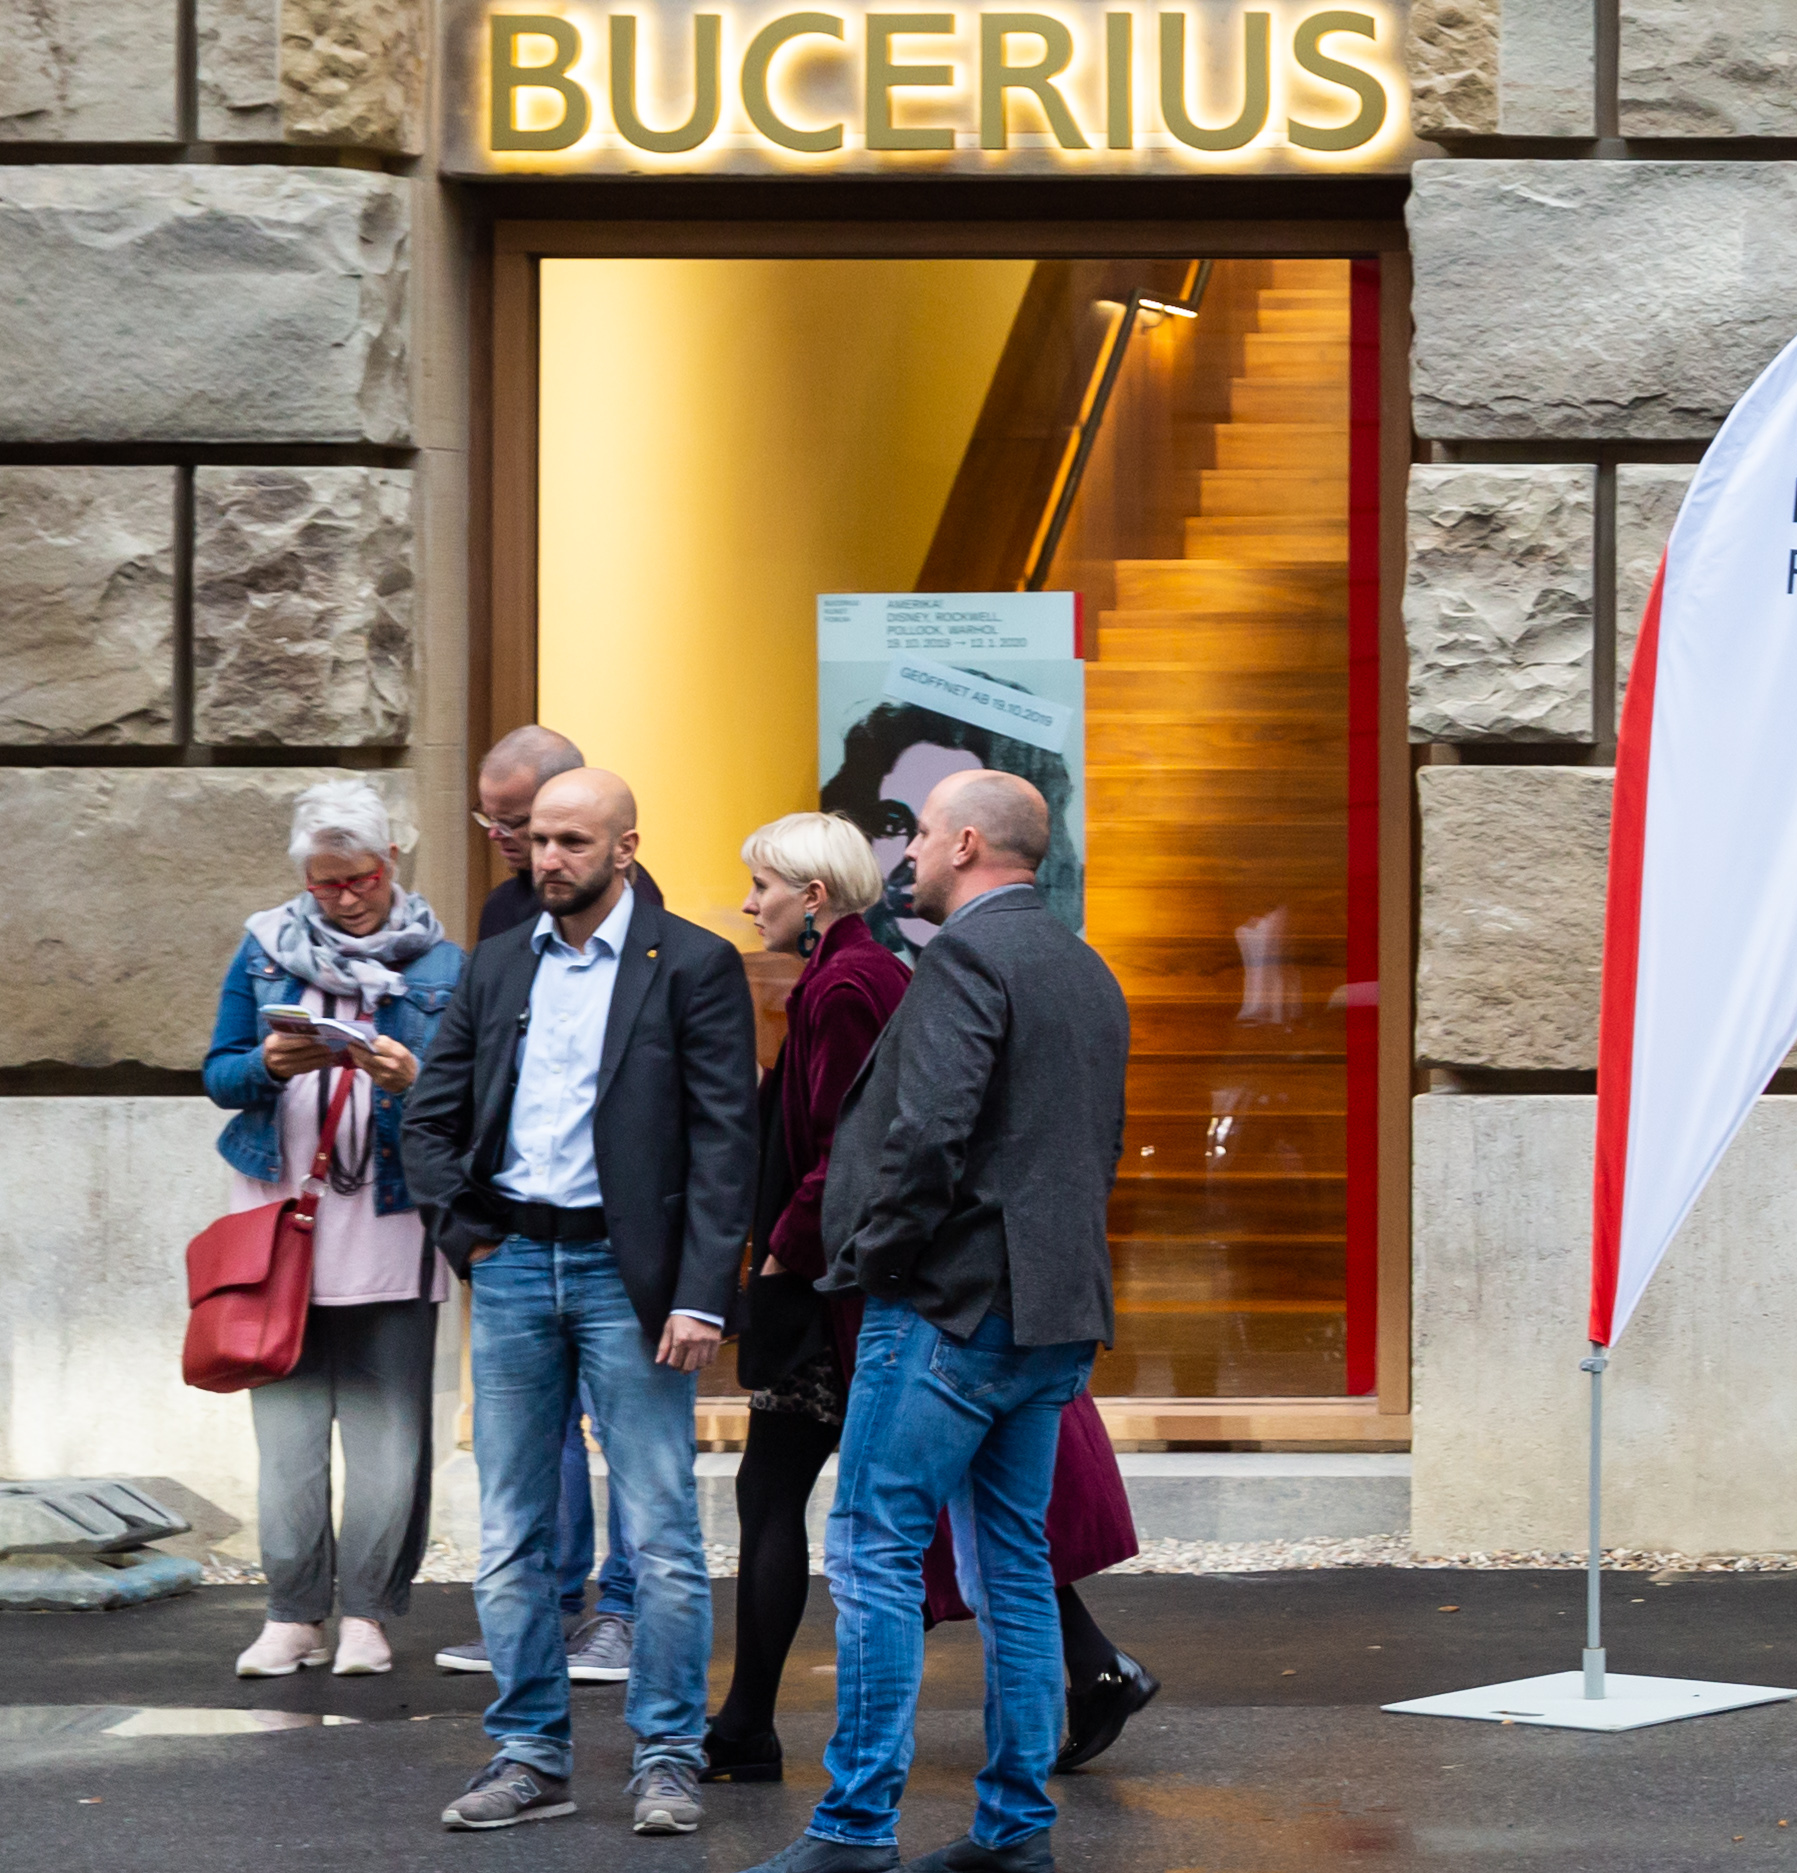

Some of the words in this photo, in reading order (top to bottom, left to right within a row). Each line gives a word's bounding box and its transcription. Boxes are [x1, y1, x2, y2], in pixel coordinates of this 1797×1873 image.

[490, 11, 1387, 151] BUCERIUS
[972, 692, 990, 705] AB
[992, 699, 1053, 727] 19.10.2019
